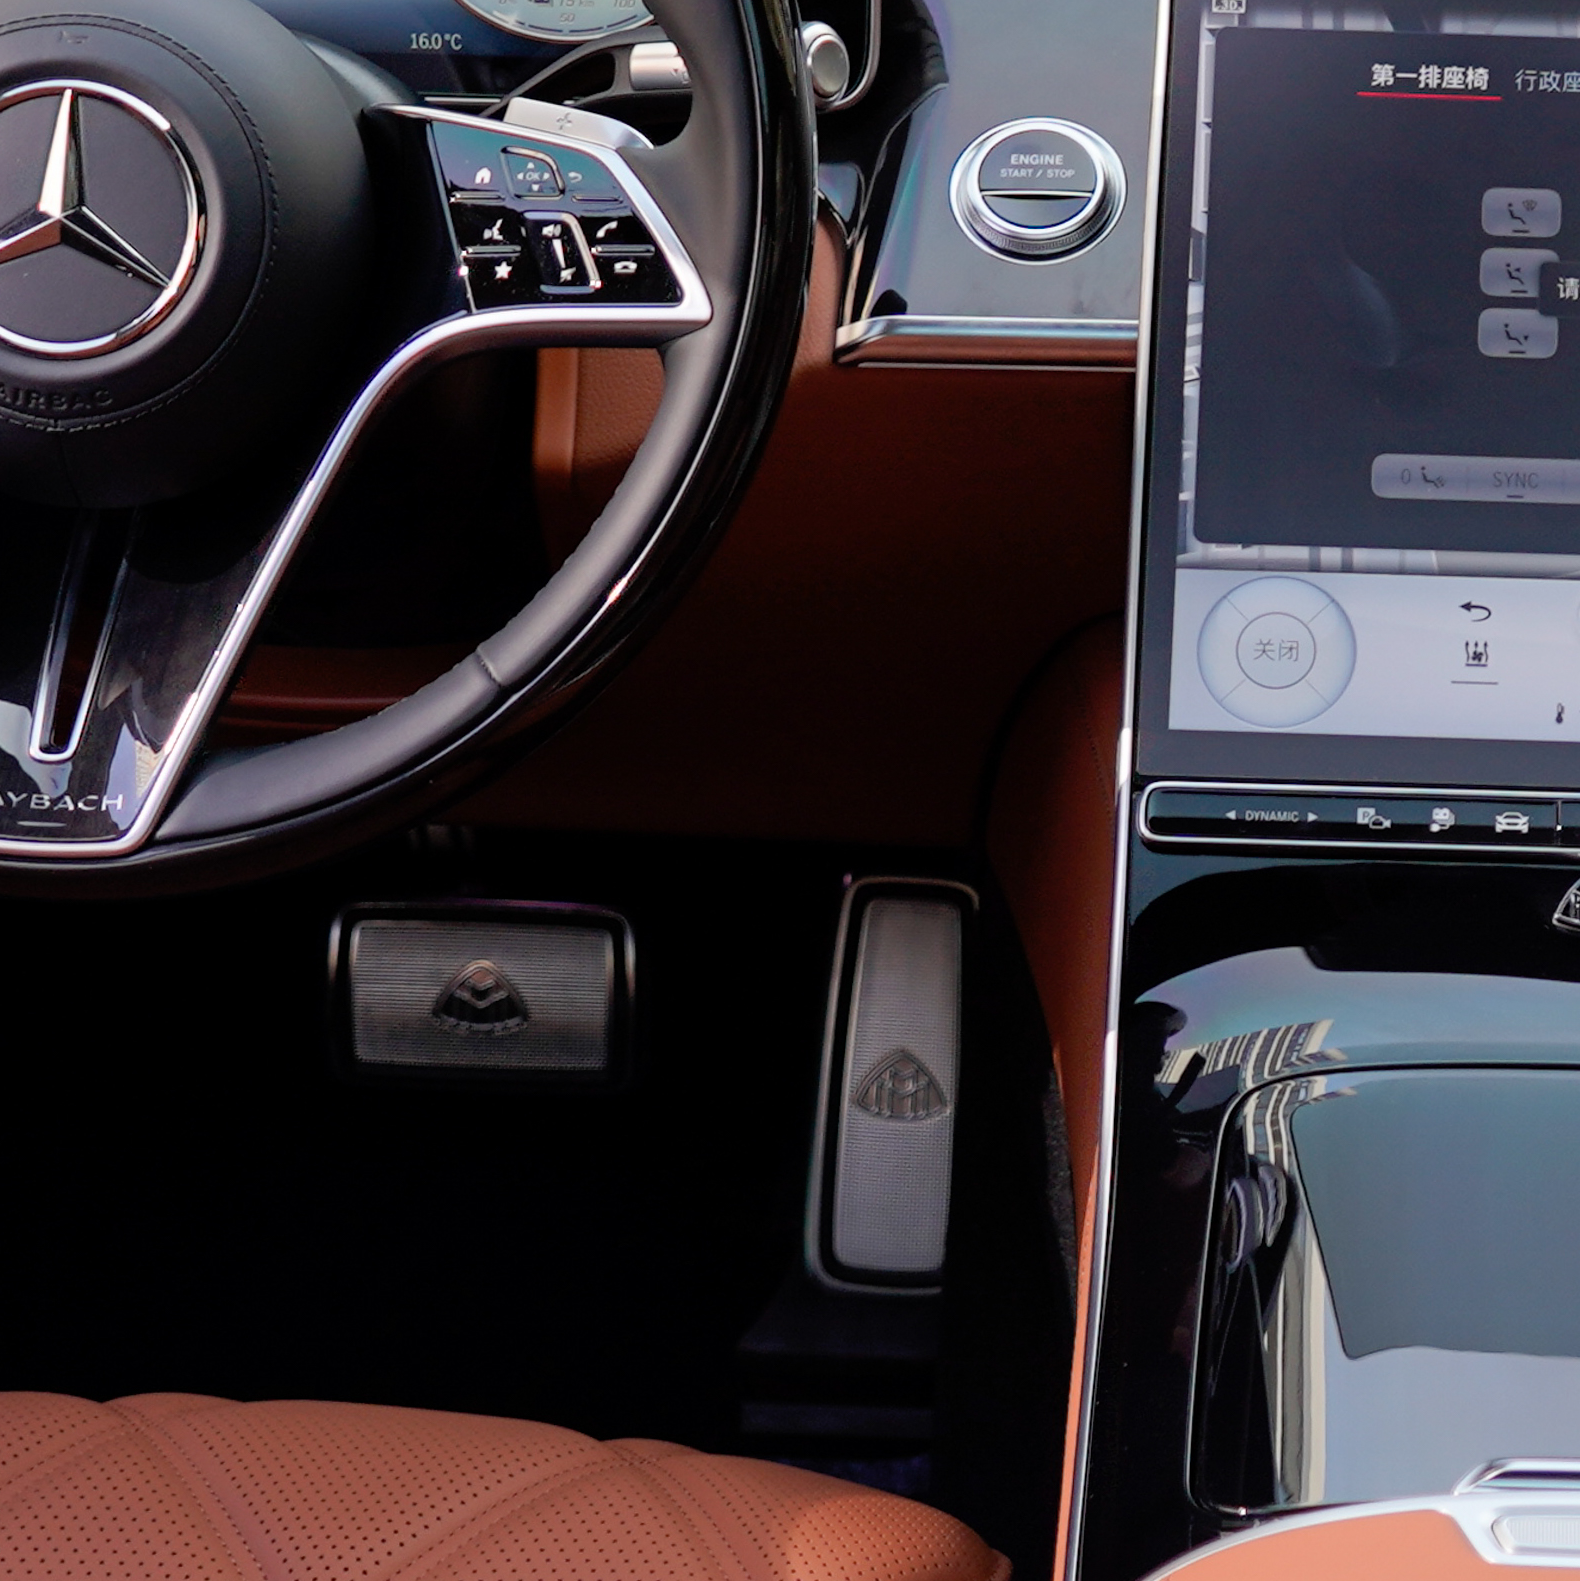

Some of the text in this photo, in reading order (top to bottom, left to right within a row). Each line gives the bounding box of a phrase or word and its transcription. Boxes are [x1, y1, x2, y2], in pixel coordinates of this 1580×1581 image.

[1371, 63, 1490, 91] 第一排座椅
[1010, 153, 1064, 166] ENGINE
[525, 171, 542, 182] OK
[1000, 168, 1034, 178] START
[1046, 168, 1076, 179] STOP
[1492, 471, 1540, 489] SYNC
[1252, 638, 1300, 663] 关闭
[1244, 809, 1300, 823] DYNAMIC
